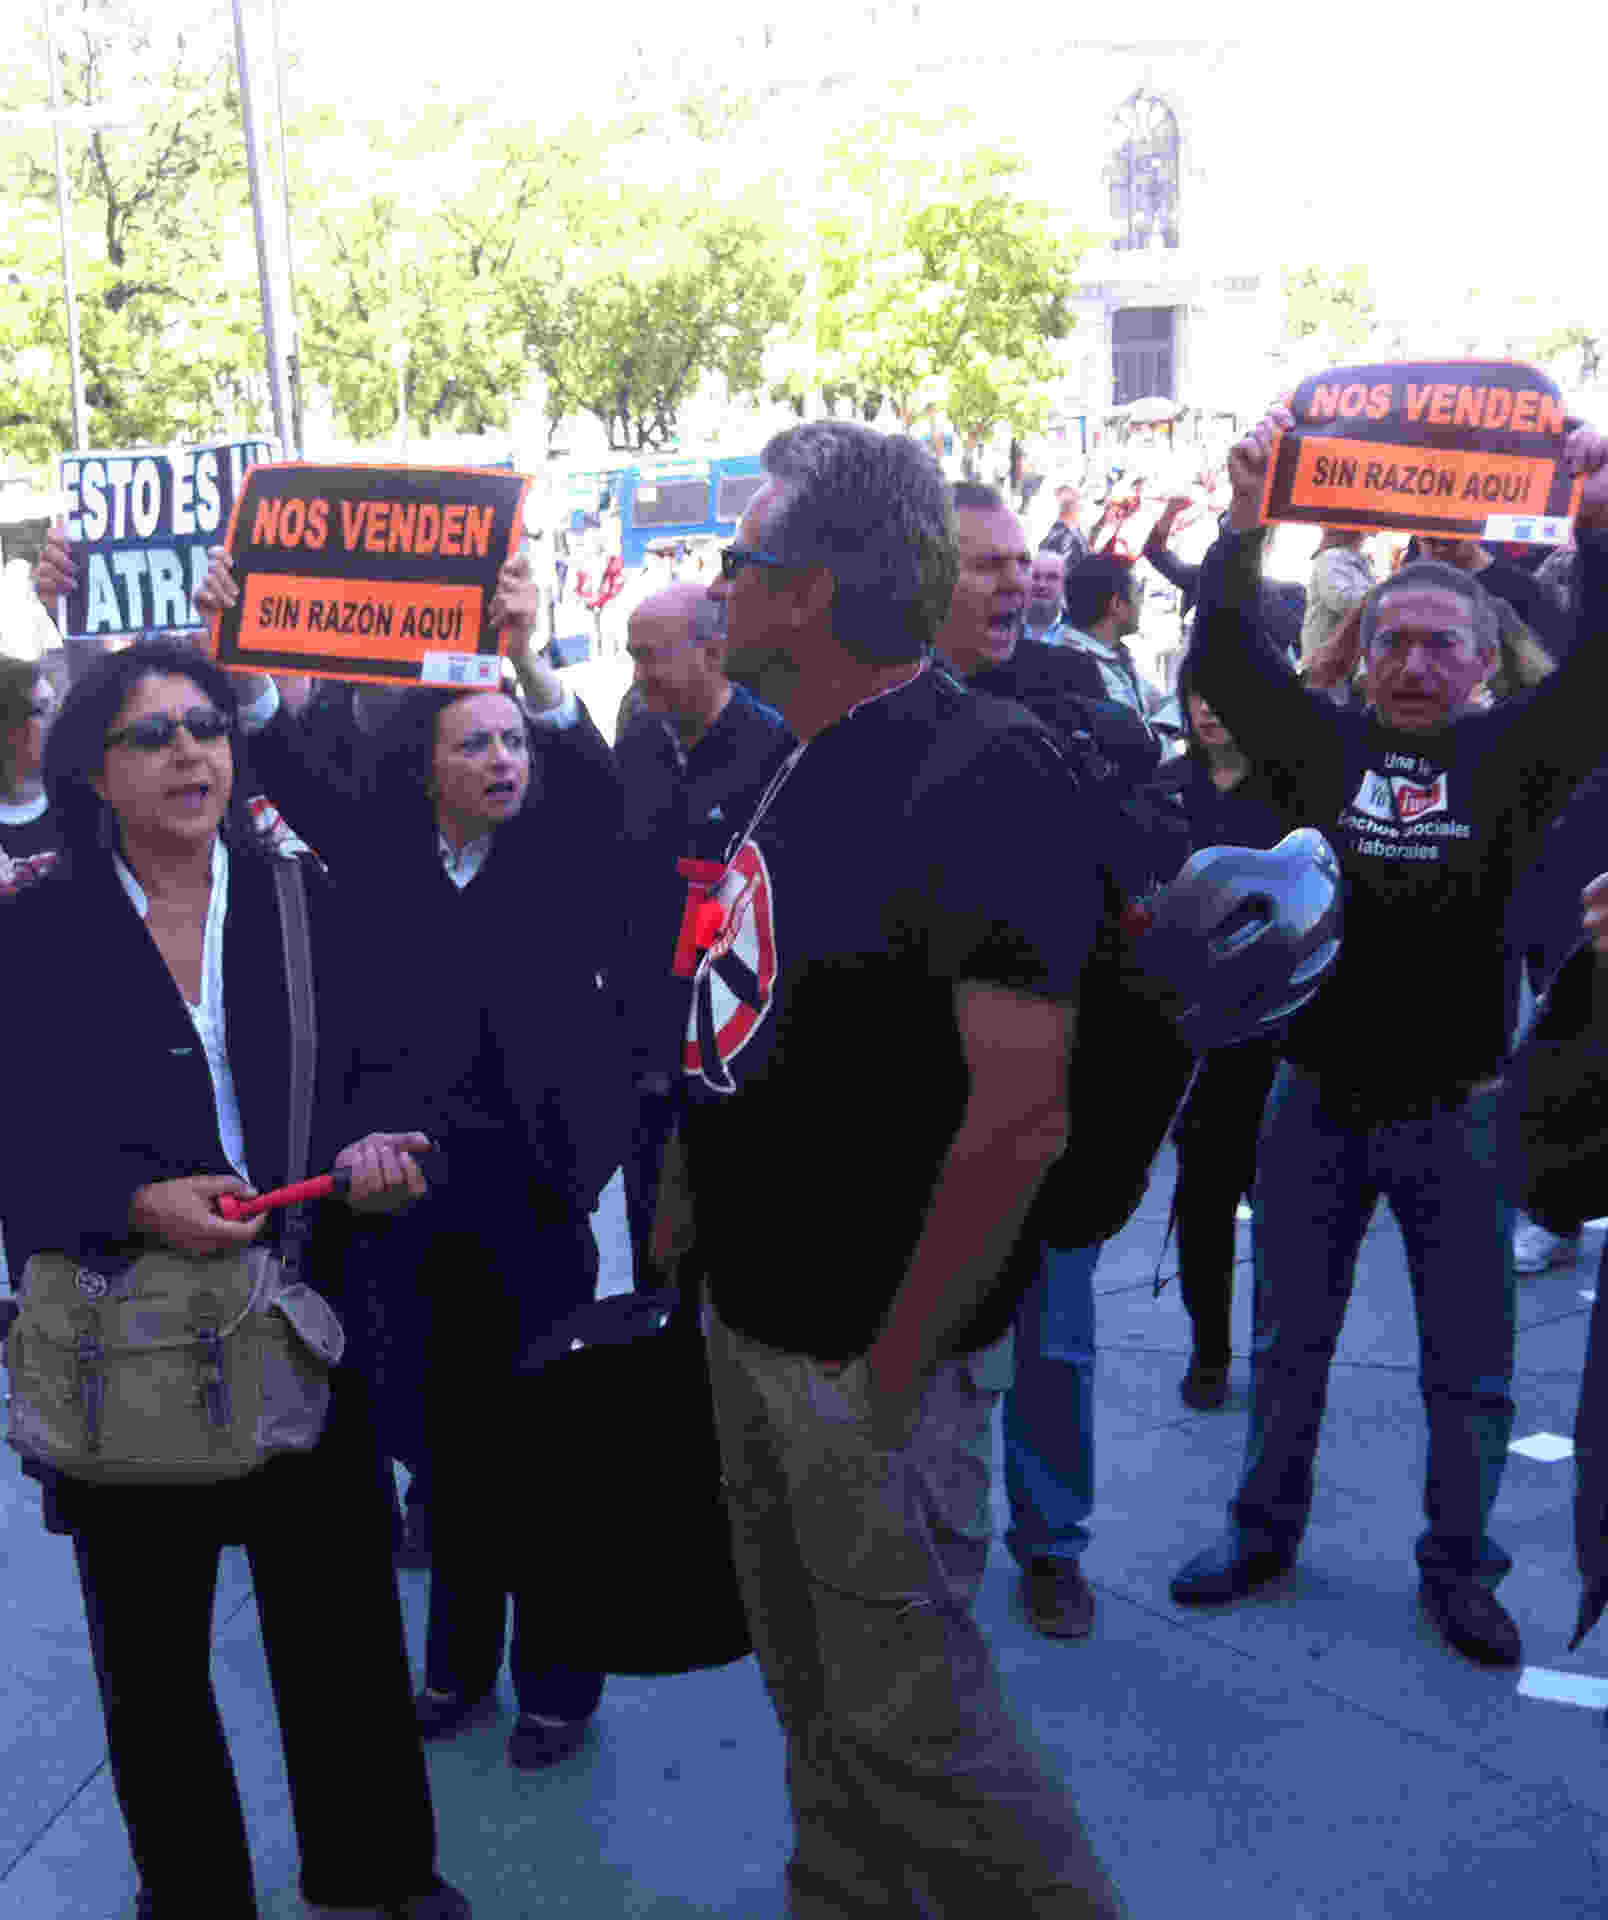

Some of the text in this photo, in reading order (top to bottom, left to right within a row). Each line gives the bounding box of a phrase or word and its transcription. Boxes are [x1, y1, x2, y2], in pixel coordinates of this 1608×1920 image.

[1309, 383, 1566, 432] NOS VENDEN
[63, 458, 161, 543] ESTO
[171, 452, 221, 535] ES
[1311, 456, 1358, 487] SIN
[1365, 461, 1455, 498] RAZÓN
[253, 499, 496, 556] NOS VENDEN
[259, 593, 464, 640] SIN RAZÓN AQUÍ
